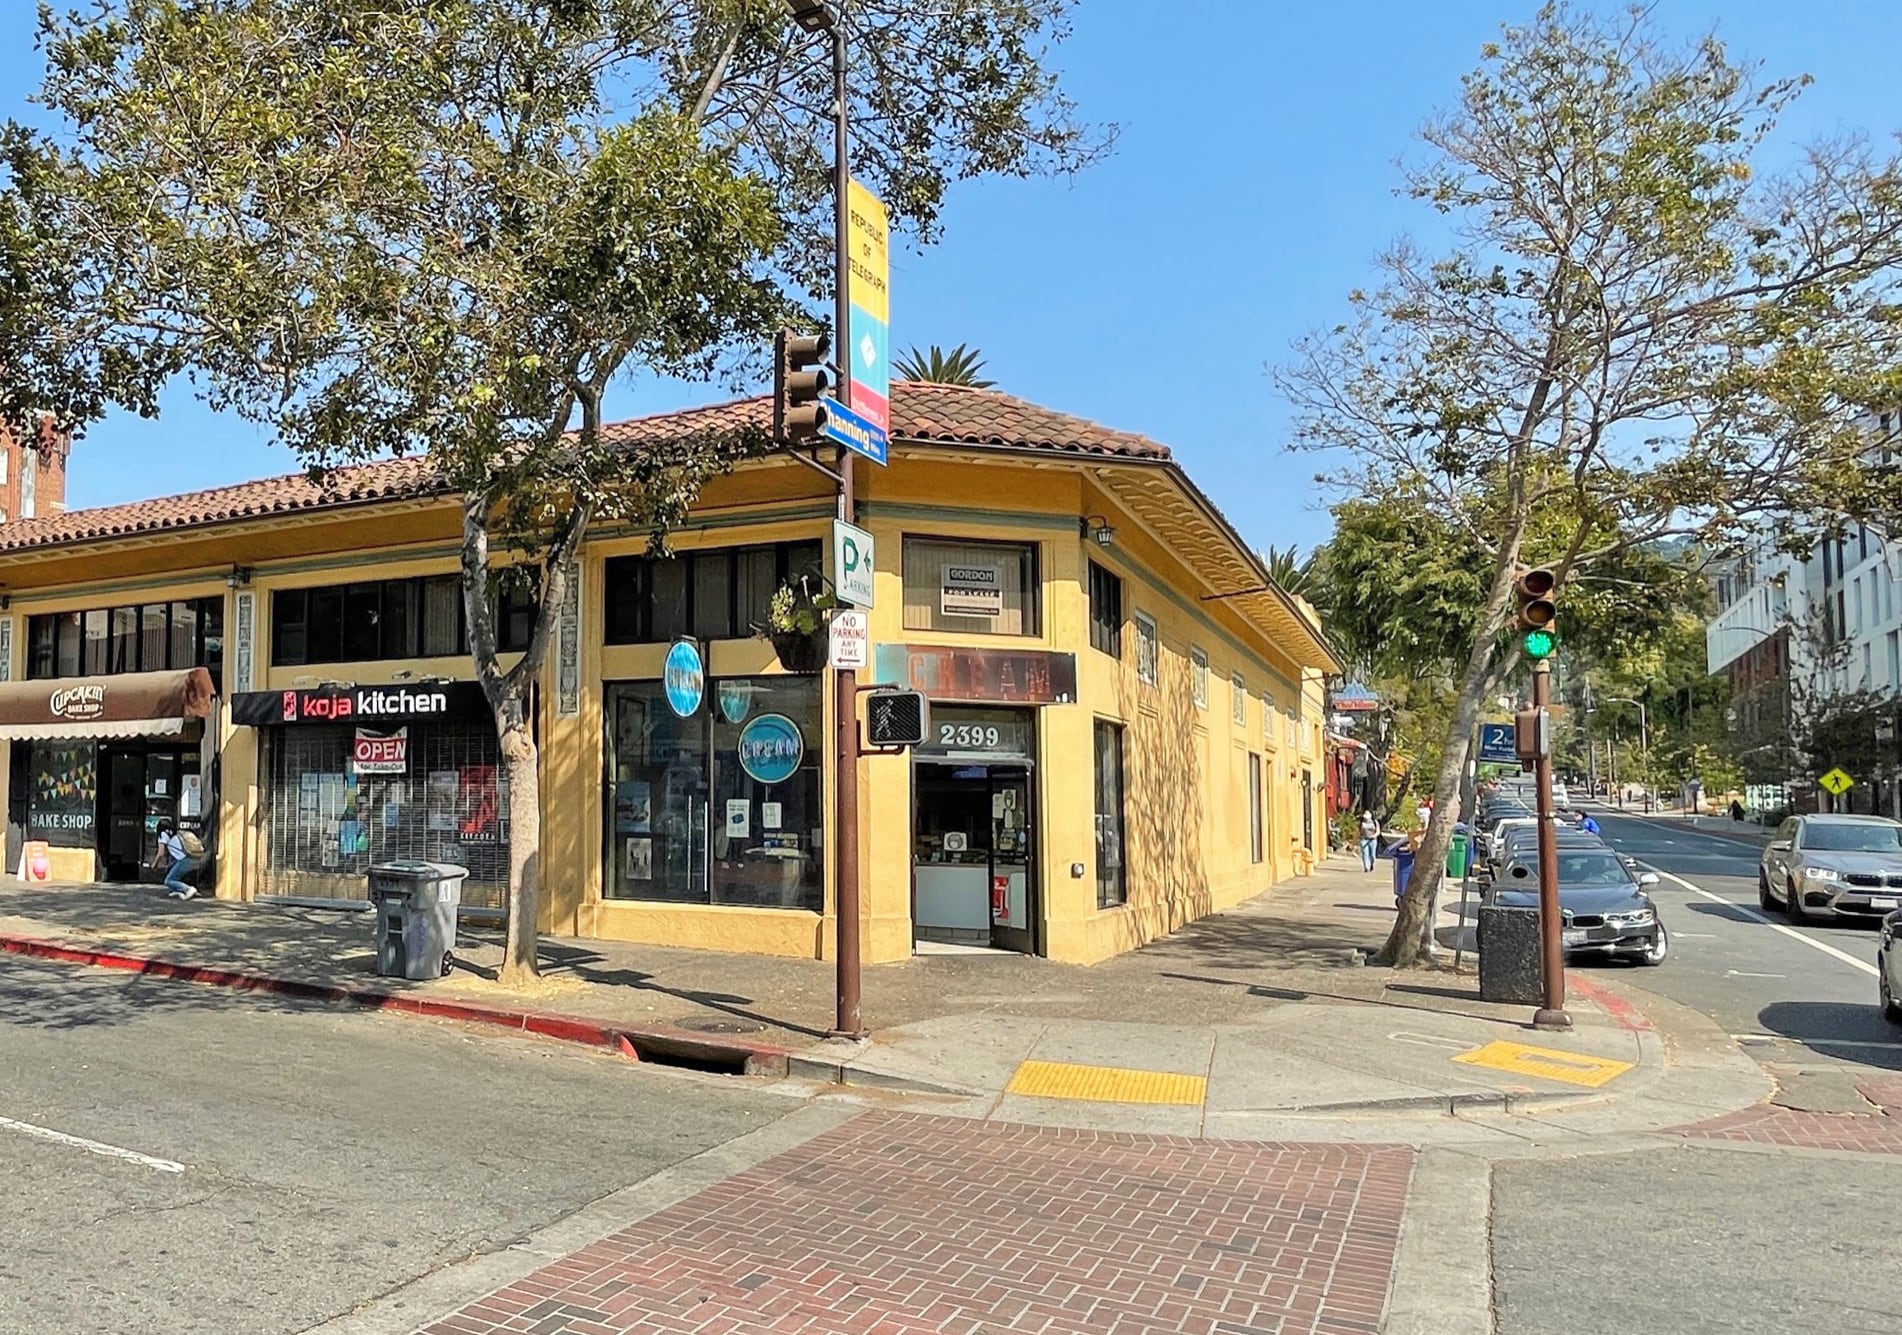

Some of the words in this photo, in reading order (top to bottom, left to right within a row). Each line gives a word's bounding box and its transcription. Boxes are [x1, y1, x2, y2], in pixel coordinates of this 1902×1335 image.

[851, 209, 883, 245] REPUBLIC
[863, 243, 871, 259] OF
[848, 256, 885, 295] TELEGRAPH
[950, 569, 994, 582] GORDON
[842, 616, 857, 628] NO
[832, 628, 865, 640] PARKING
[841, 640, 856, 648] ANY
[840, 648, 858, 657] TIME
[907, 652, 1051, 696] CREAM
[303, 694, 352, 720] koja
[357, 689, 447, 715] kitchen
[940, 724, 999, 747] 2399
[356, 741, 406, 760] OPEN
[31, 814, 60, 829] BAKE
[62, 814, 92, 829] SHOP
